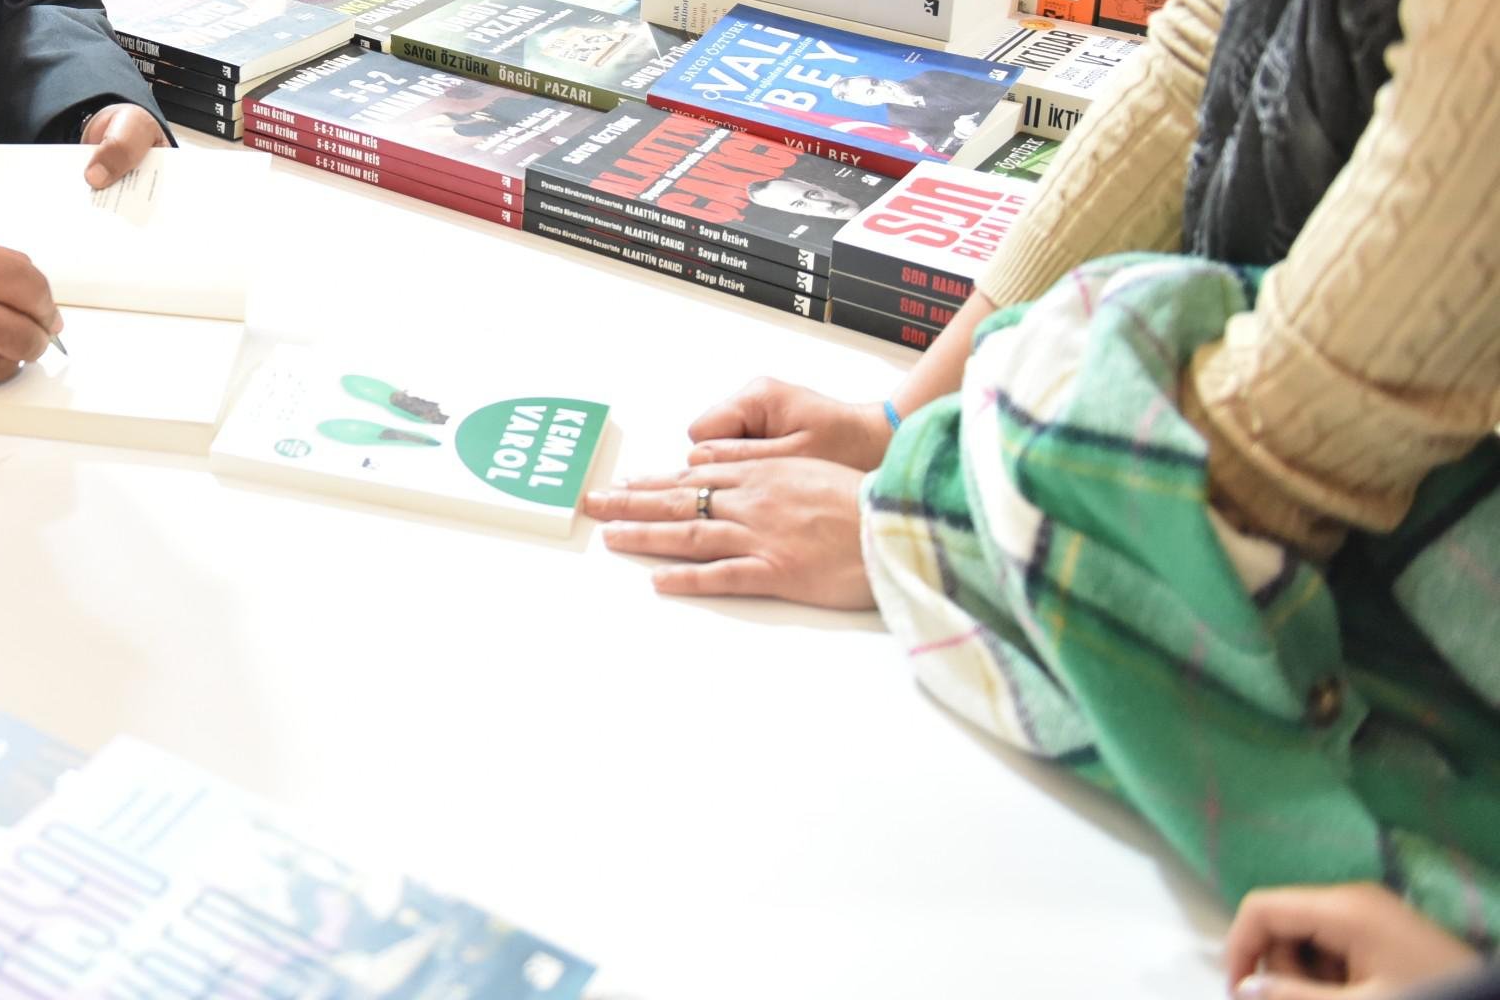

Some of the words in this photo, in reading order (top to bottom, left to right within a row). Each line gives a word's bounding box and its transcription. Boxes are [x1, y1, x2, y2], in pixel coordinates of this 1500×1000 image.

[466, 5, 546, 44] PAZARI
[672, 4, 680, 22] DAR
[135, 38, 160, 58] ÖZTÜRK
[679, 55, 711, 83] SAYGI
[707, 20, 748, 57] ÖZTÜRK
[691, 22, 801, 95] VALİ
[1003, 29, 1089, 72] İKTİDAR
[1074, 51, 1122, 68] VE
[329, 70, 409, 104] 5-6-2
[403, 42, 436, 63] SAYGI
[440, 49, 489, 77] ÖZTÜRK
[498, 65, 540, 90] ÖRGÜT
[544, 80, 592, 104] PAZARI
[760, 39, 859, 113] BEY
[252, 103, 271, 117] SAYGI
[271, 107, 295, 125] ÖZTÜRK
[314, 121, 334, 135] 5-6-2
[335, 126, 361, 145] TAMAM
[361, 135, 378, 149] REİS
[256, 120, 273, 134] SAYGI
[274, 124, 298, 142] ÖZTÜRK
[317, 139, 337, 153] 5-6-2
[338, 143, 364, 162] TAMAM
[364, 151, 380, 167] REİS
[562, 139, 594, 165] SAYGI
[587, 114, 643, 147] ÖZTÜRK
[254, 137, 273, 152] SAYGI
[273, 141, 297, 159] ÖZTÜRK
[315, 154, 335, 169] 5-6-2
[336, 160, 362, 179] TAMAM
[362, 168, 379, 184] REİS
[995, 136, 1046, 170] ÖZTÜRK
[625, 203, 660, 226] ALAATTİN
[661, 212, 686, 230] ÇAKICI
[699, 225, 721, 243] Saygı
[721, 231, 749, 248] Öztürk
[862, 177, 1005, 249] SON
[622, 246, 658, 268] ALAATTİN
[658, 256, 683, 274] ÇAKICI
[695, 268, 718, 286] Saygı
[717, 274, 745, 293] Öztürk
[624, 225, 659, 246] ALAATTİN
[660, 234, 685, 253] ÇAKICI
[697, 247, 719, 265] Saygı
[720, 252, 748, 270] Öztürk
[901, 266, 928, 286] SON
[900, 296, 926, 318] SON
[901, 326, 928, 347] SON
[486, 405, 548, 482] VAROL
[528, 407, 588, 488] KEMAL
